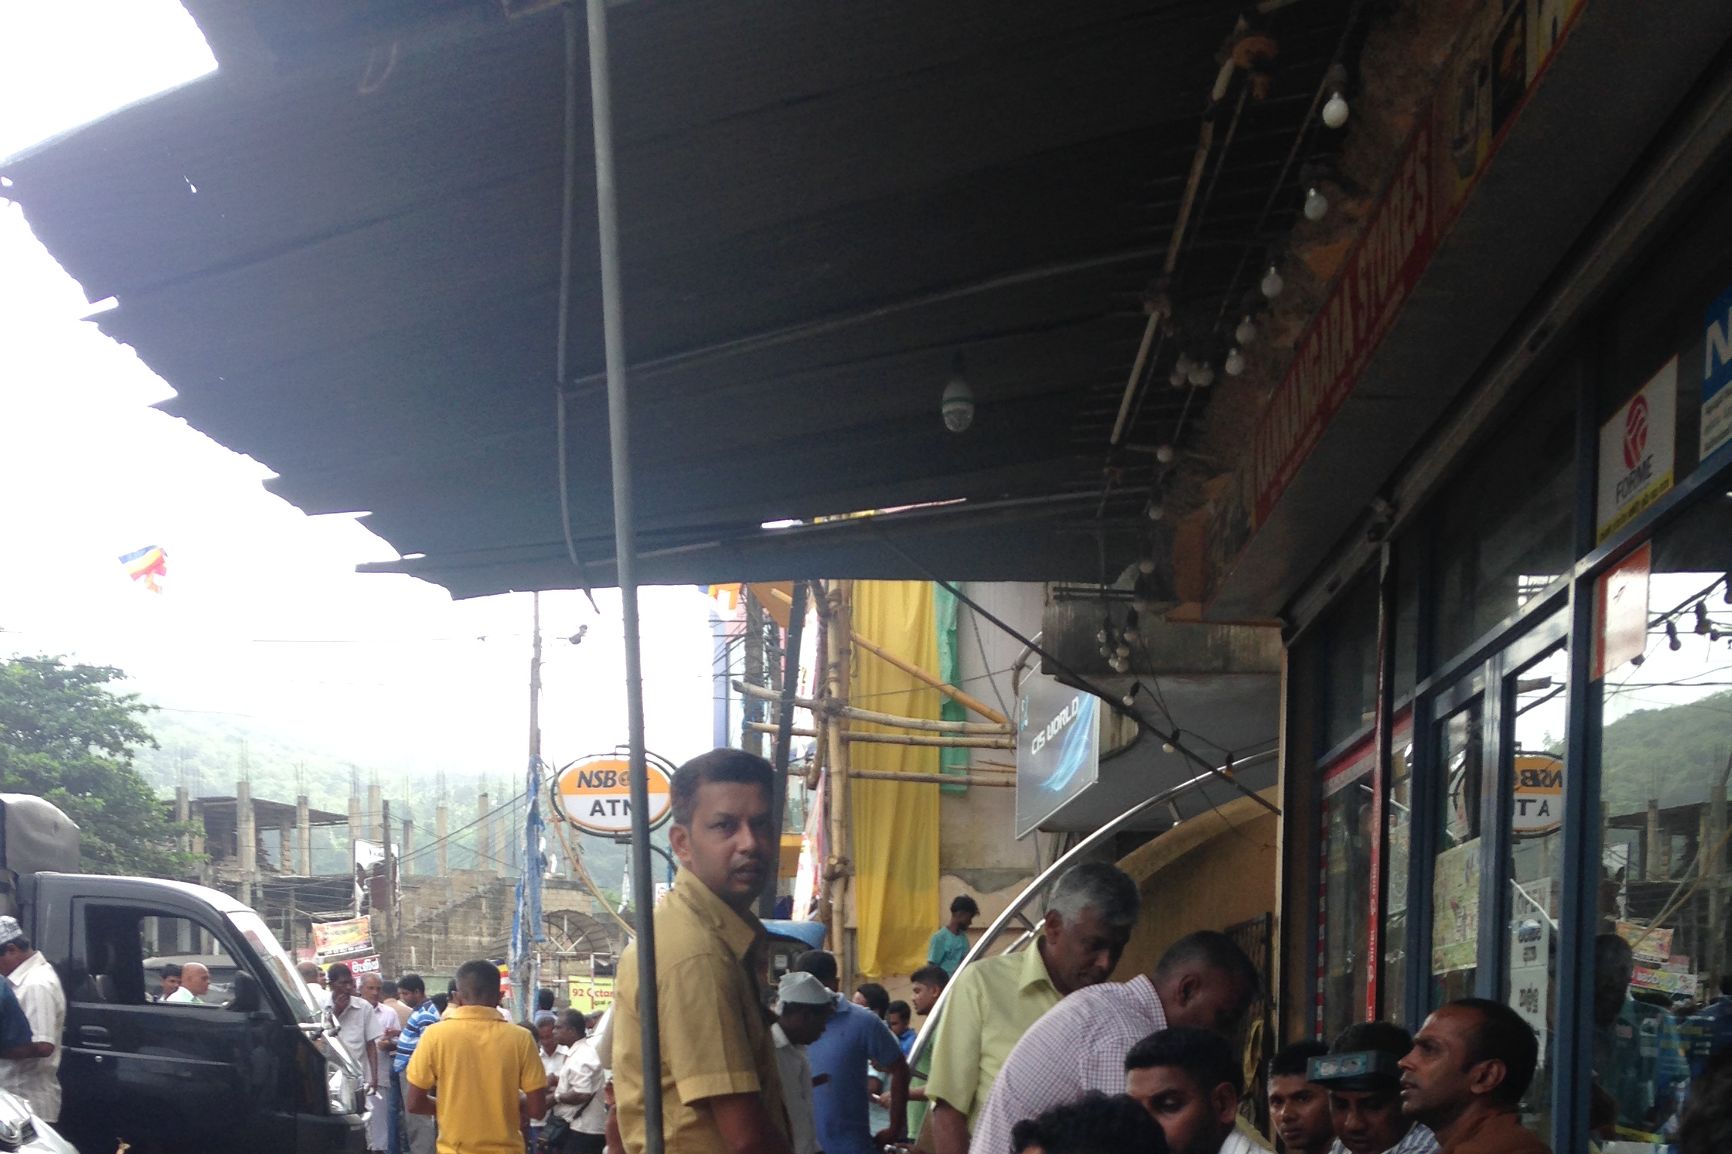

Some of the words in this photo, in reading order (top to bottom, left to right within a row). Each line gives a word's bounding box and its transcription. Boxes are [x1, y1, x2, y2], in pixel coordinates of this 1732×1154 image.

[1358, 128, 1427, 324] STORES
[1046, 695, 1079, 742] WORLD
[577, 770, 617, 788] NSB
[572, 988, 584, 997] 92
